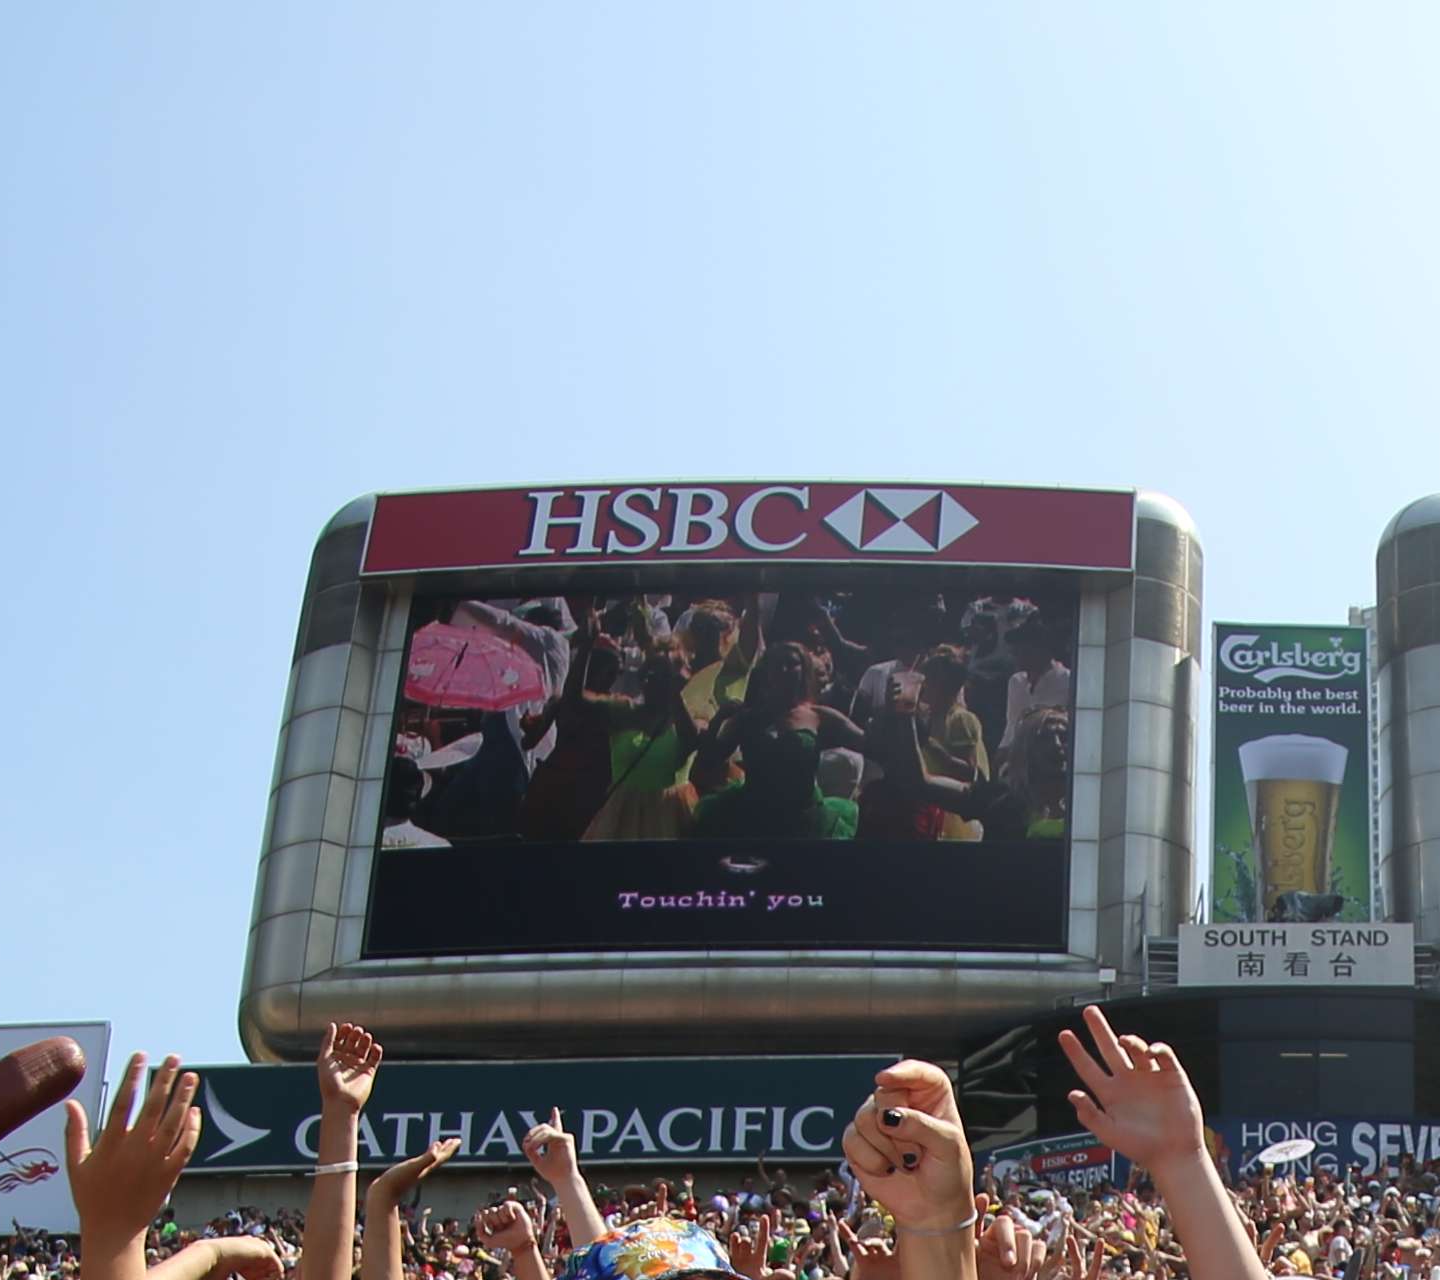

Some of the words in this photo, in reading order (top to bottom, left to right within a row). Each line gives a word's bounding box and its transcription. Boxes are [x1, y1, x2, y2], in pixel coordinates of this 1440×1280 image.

[518, 485, 812, 557] HSBC
[1219, 634, 1362, 675] Carlsberg
[1219, 686, 1292, 703] Probably
[1296, 688, 1321, 700] the
[1325, 688, 1359, 701] best
[1219, 701, 1254, 713] beer
[1259, 702, 1274, 714] in
[1279, 701, 1306, 714] the
[1310, 702, 1362, 715] world.
[618, 889, 755, 910] Touchin'
[767, 894, 824, 914] you
[1204, 929, 1288, 947] SOUTH
[1311, 929, 1390, 947] STAND
[1236, 951, 1357, 978] 南看台
[582, 1105, 836, 1153] PACIFIC
[1241, 1121, 1339, 1148] HONG
[1239, 1151, 1339, 1178] KNG
